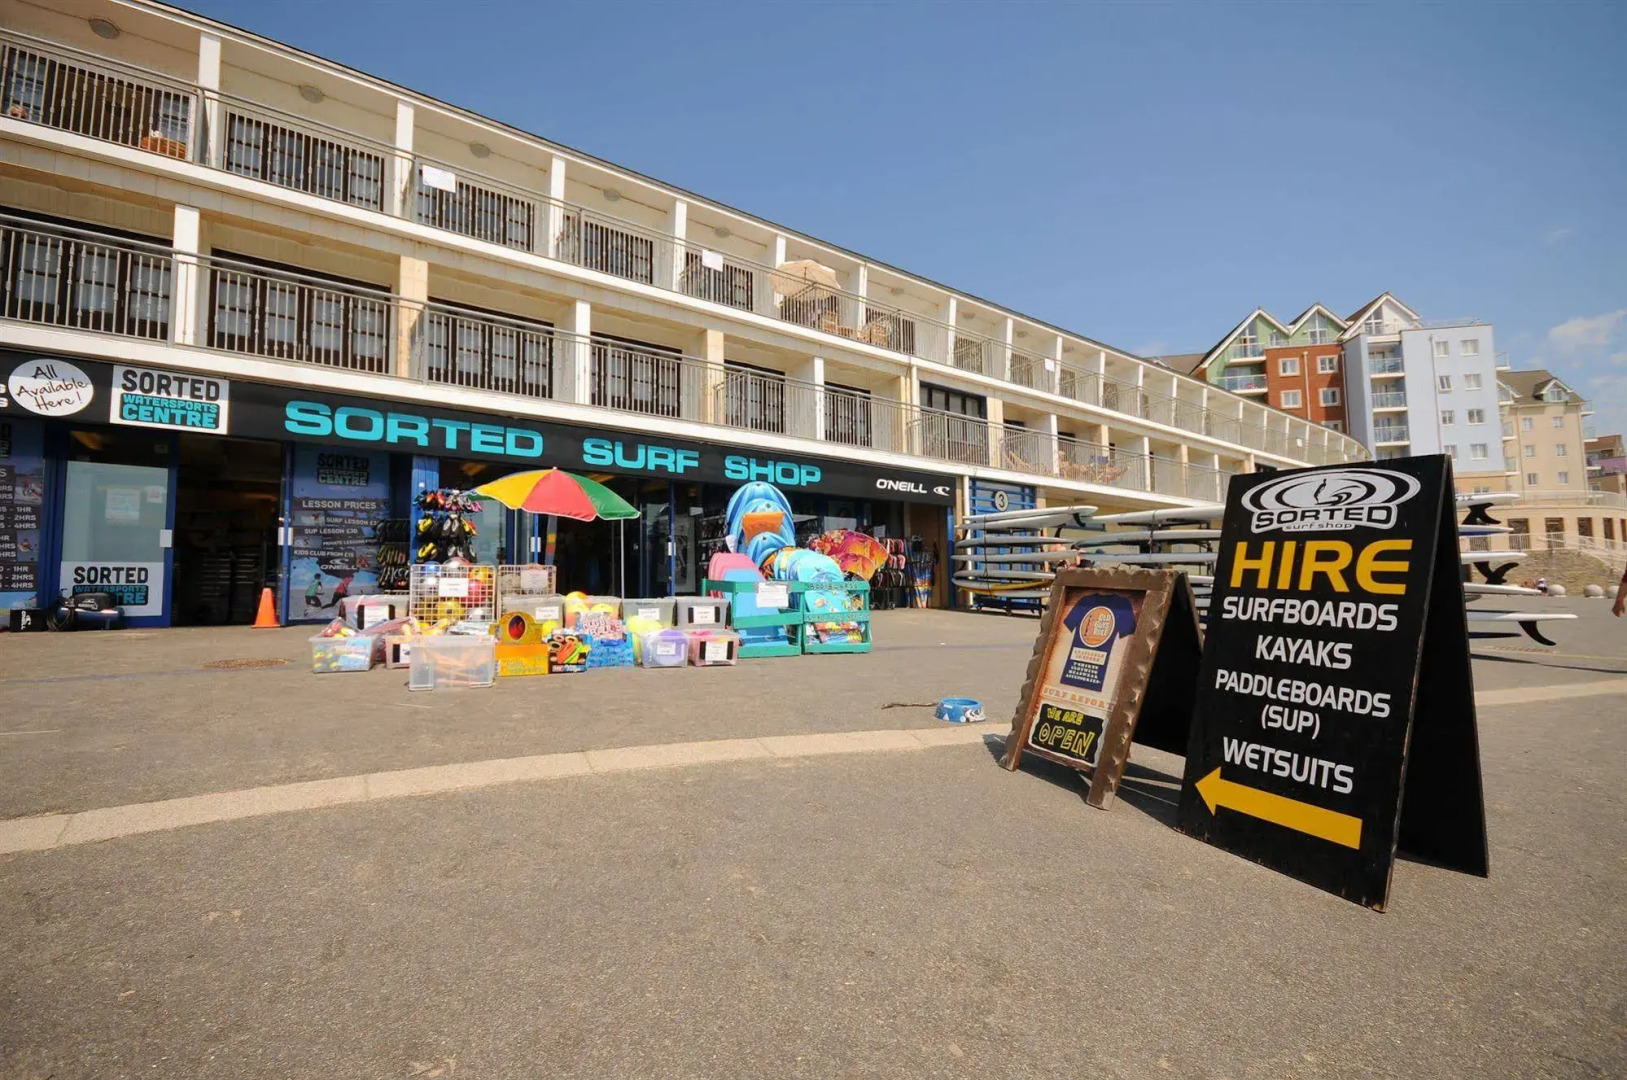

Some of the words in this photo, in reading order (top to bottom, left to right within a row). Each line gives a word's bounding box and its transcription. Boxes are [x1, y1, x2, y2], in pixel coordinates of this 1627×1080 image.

[31, 364, 58, 380] All
[16, 377, 88, 398] Available
[121, 369, 220, 402] SORTED
[123, 394, 218, 413] WATERSPORTS
[122, 404, 217, 428] CENTRE
[284, 400, 544, 458] SORTED
[582, 438, 699, 474] SURF
[724, 455, 821, 487] SHOP
[318, 474, 367, 486] CENTRE
[876, 478, 928, 494] O'NEILL
[302, 500, 341, 509] LESSON
[344, 501, 377, 510] PRICES
[998, 493, 1005, 509] 3
[344, 518, 369, 526] LESSON
[1255, 506, 1393, 529] SORTED
[1285, 522, 1315, 531] surf
[1318, 522, 1353, 531] shop
[73, 566, 149, 584] SORTED
[1230, 539, 1413, 595] HIRE
[1222, 596, 1399, 632] SURFBOARDS
[1255, 635, 1353, 670] KAYAKS
[1215, 669, 1391, 718] PADDLEBOARDS
[1047, 707, 1062, 721] WE
[1062, 711, 1085, 726] ARE
[1261, 704, 1321, 740] (SUP)
[1038, 722, 1096, 757] OPEN
[1223, 736, 1354, 795] WETSUITS
